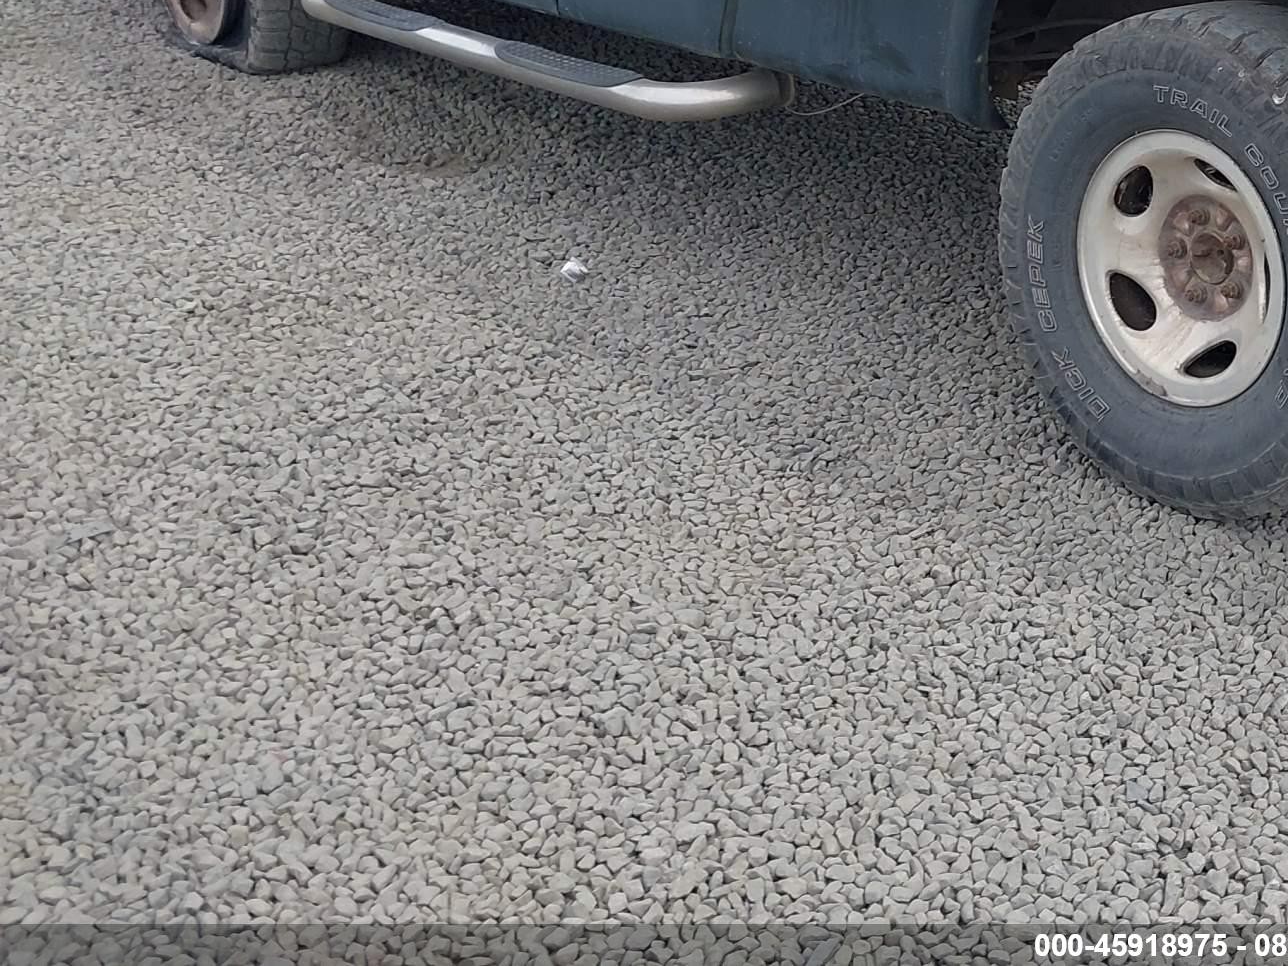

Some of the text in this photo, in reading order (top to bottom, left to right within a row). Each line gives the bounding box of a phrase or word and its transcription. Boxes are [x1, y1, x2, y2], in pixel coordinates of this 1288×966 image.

[1153, 85, 1232, 138] TRAIL
[1027, 214, 1110, 422] DICK CEPEK
